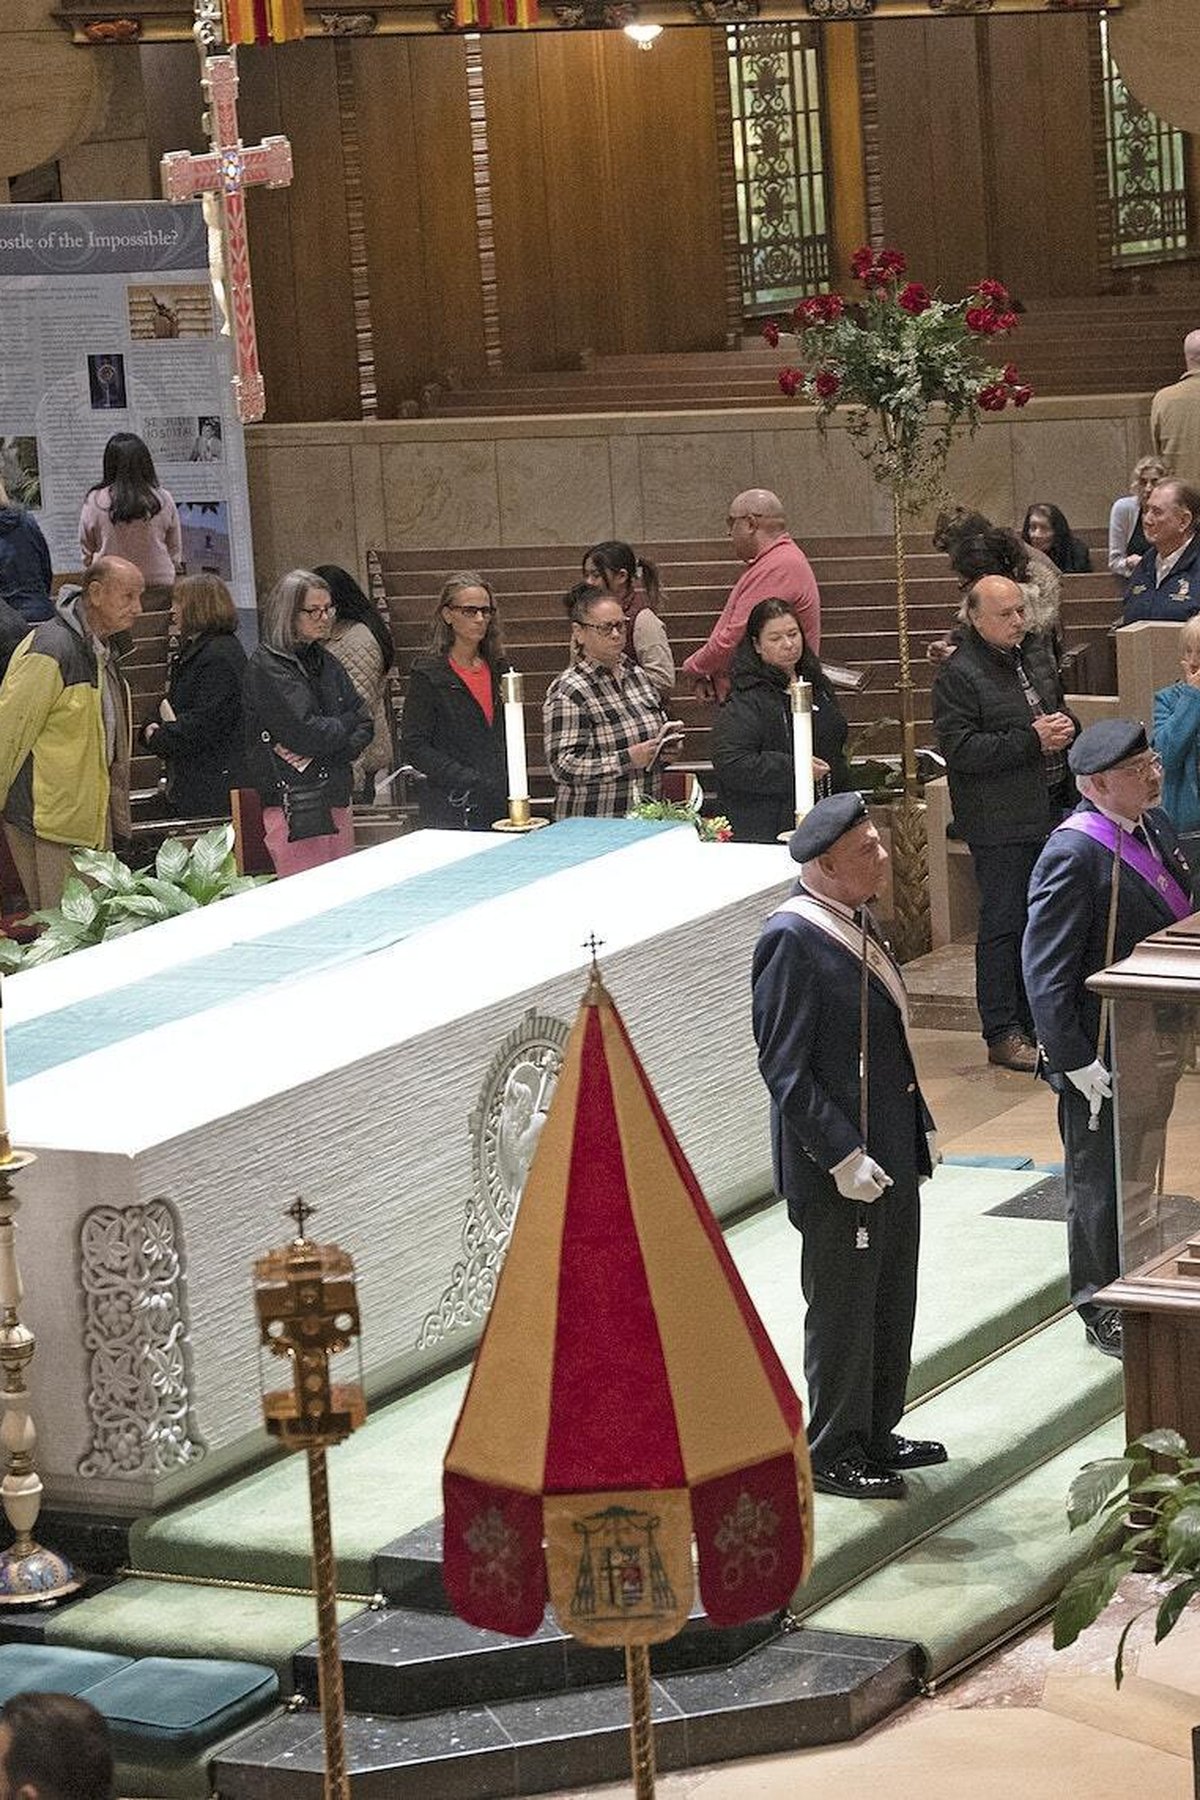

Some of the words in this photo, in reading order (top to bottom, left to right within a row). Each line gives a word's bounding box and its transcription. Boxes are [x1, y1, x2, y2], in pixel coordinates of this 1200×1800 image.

[0, 233, 34, 249] ostle
[38, 230, 56, 248] of
[58, 232, 83, 248] the
[87, 229, 179, 252] Impossible?
